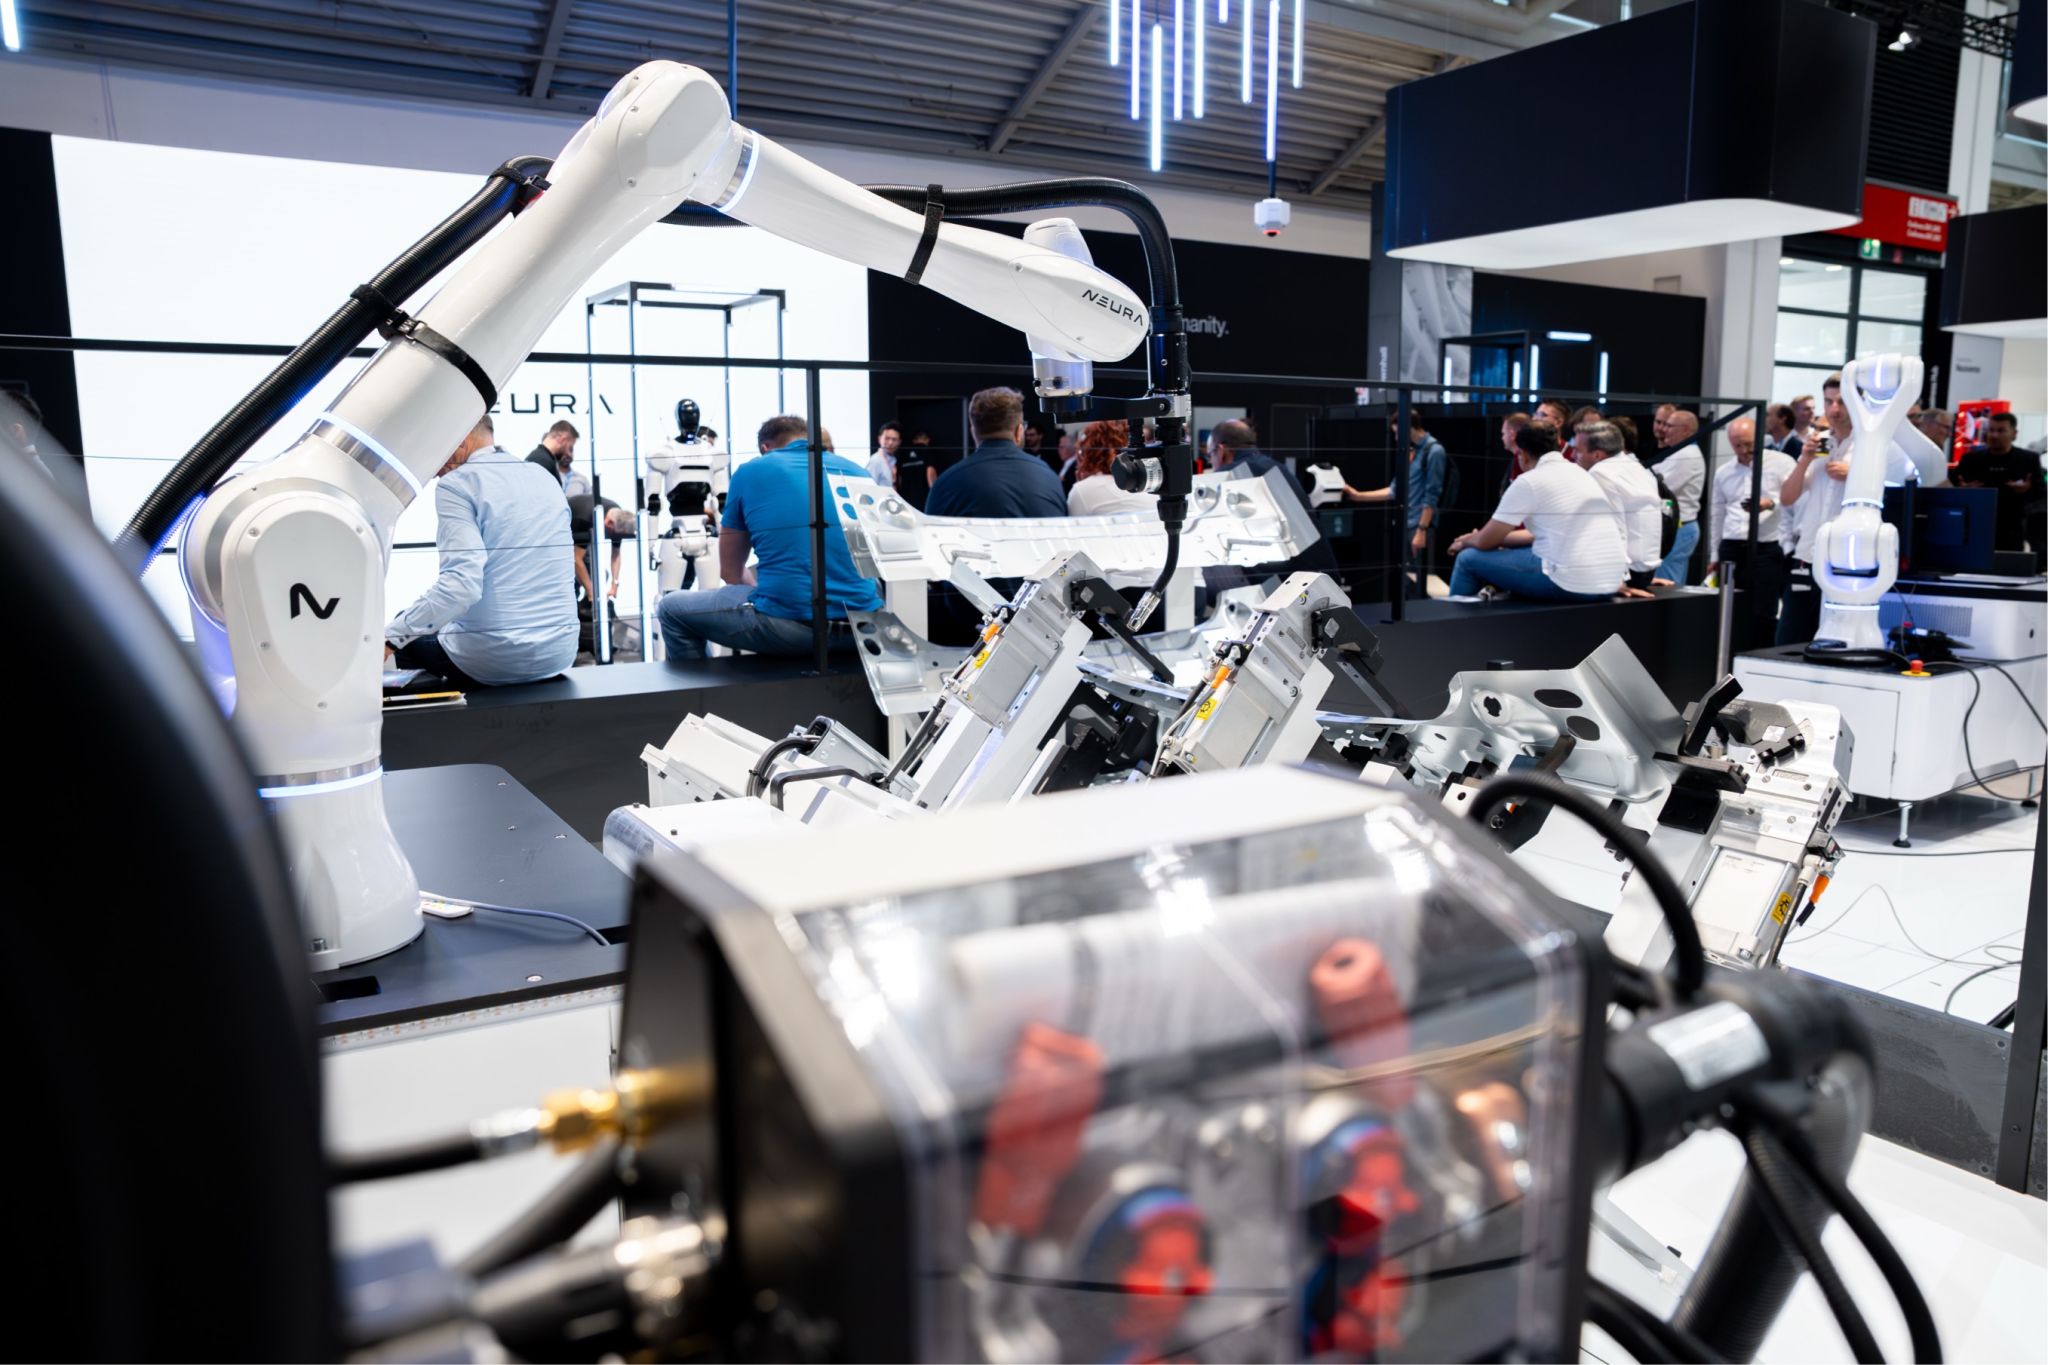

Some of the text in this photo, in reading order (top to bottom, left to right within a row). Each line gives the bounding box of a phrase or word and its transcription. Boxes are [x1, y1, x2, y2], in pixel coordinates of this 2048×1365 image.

[1082, 289, 1144, 326] NEURA
[1181, 315, 1230, 338] manity.
[489, 393, 614, 414] URA
